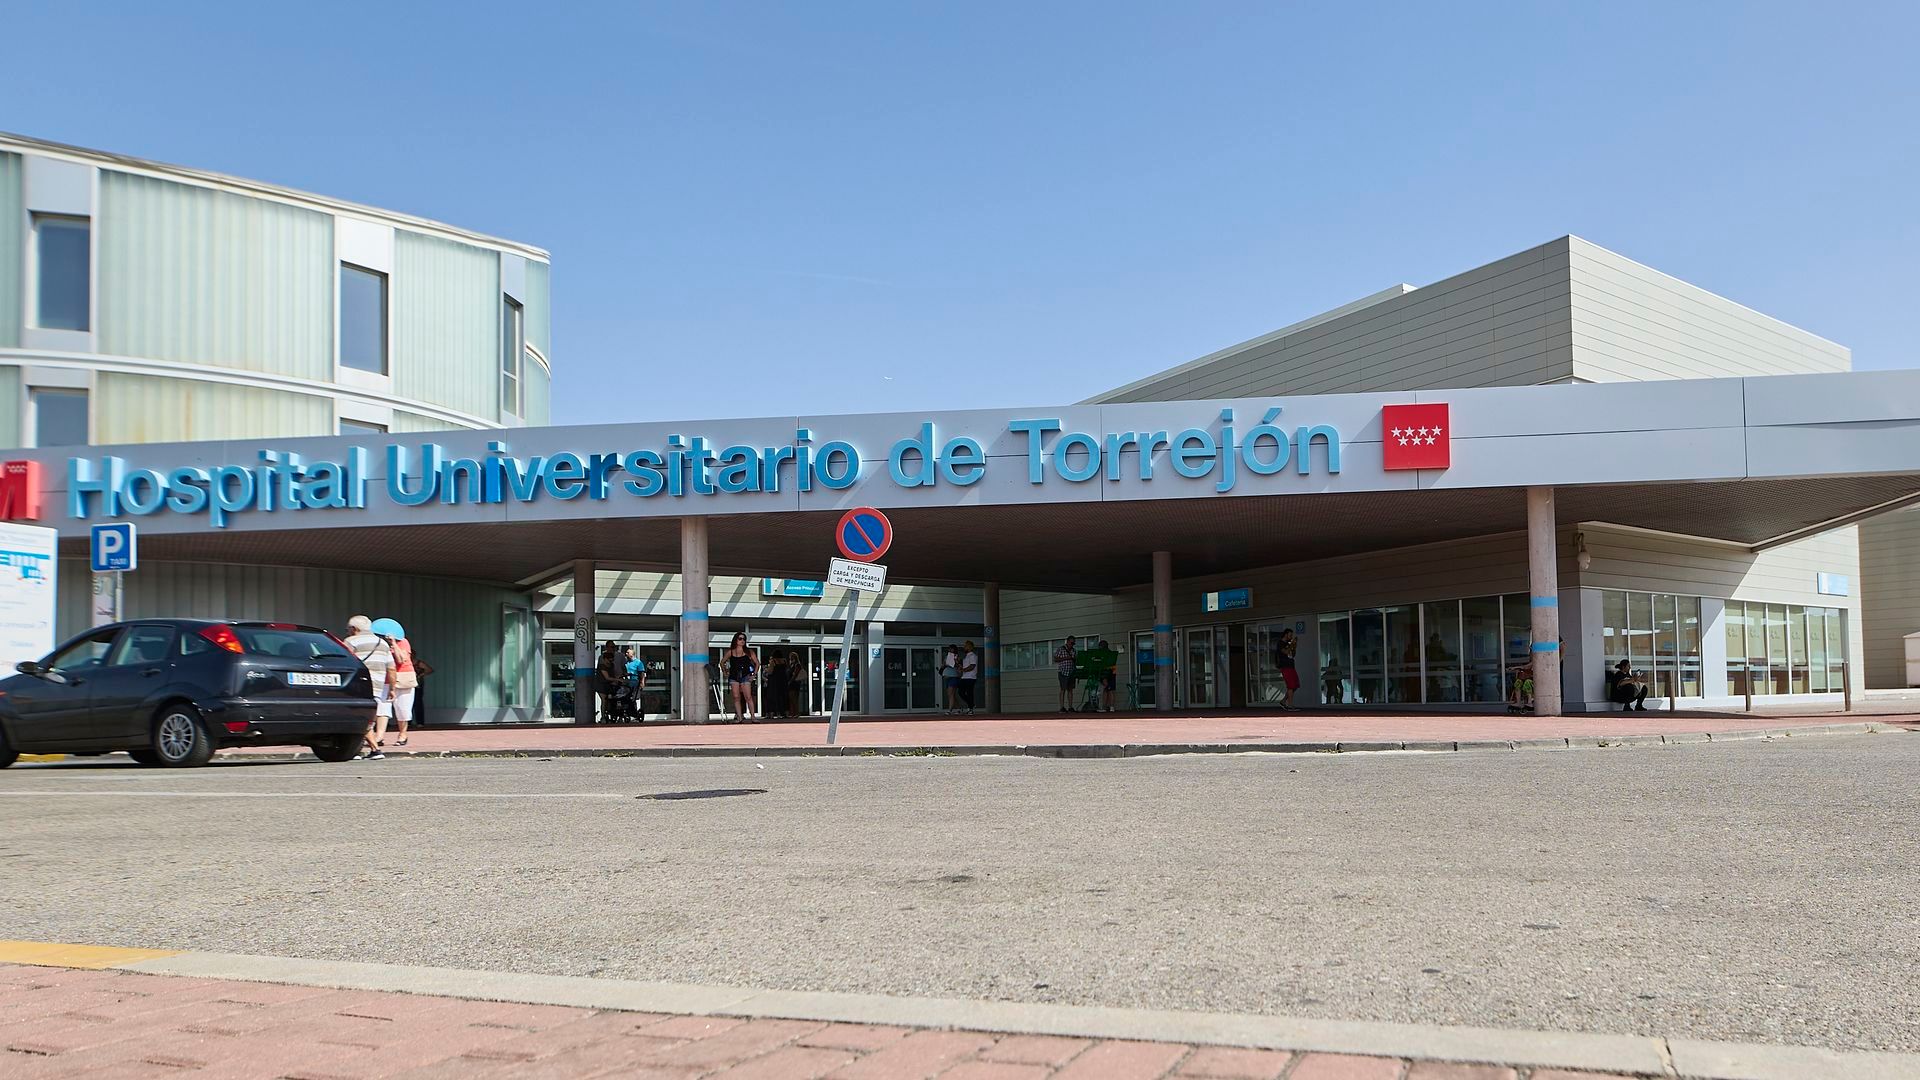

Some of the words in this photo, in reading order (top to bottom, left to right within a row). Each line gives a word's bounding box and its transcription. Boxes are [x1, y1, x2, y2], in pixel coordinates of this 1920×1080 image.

[67, 446, 367, 528] Hospital
[386, 428, 862, 506] Universitario
[888, 420, 987, 488] de
[1008, 407, 1341, 493] Torrejón
[98, 530, 123, 566] P
[854, 573, 880, 582] DESCARGA
